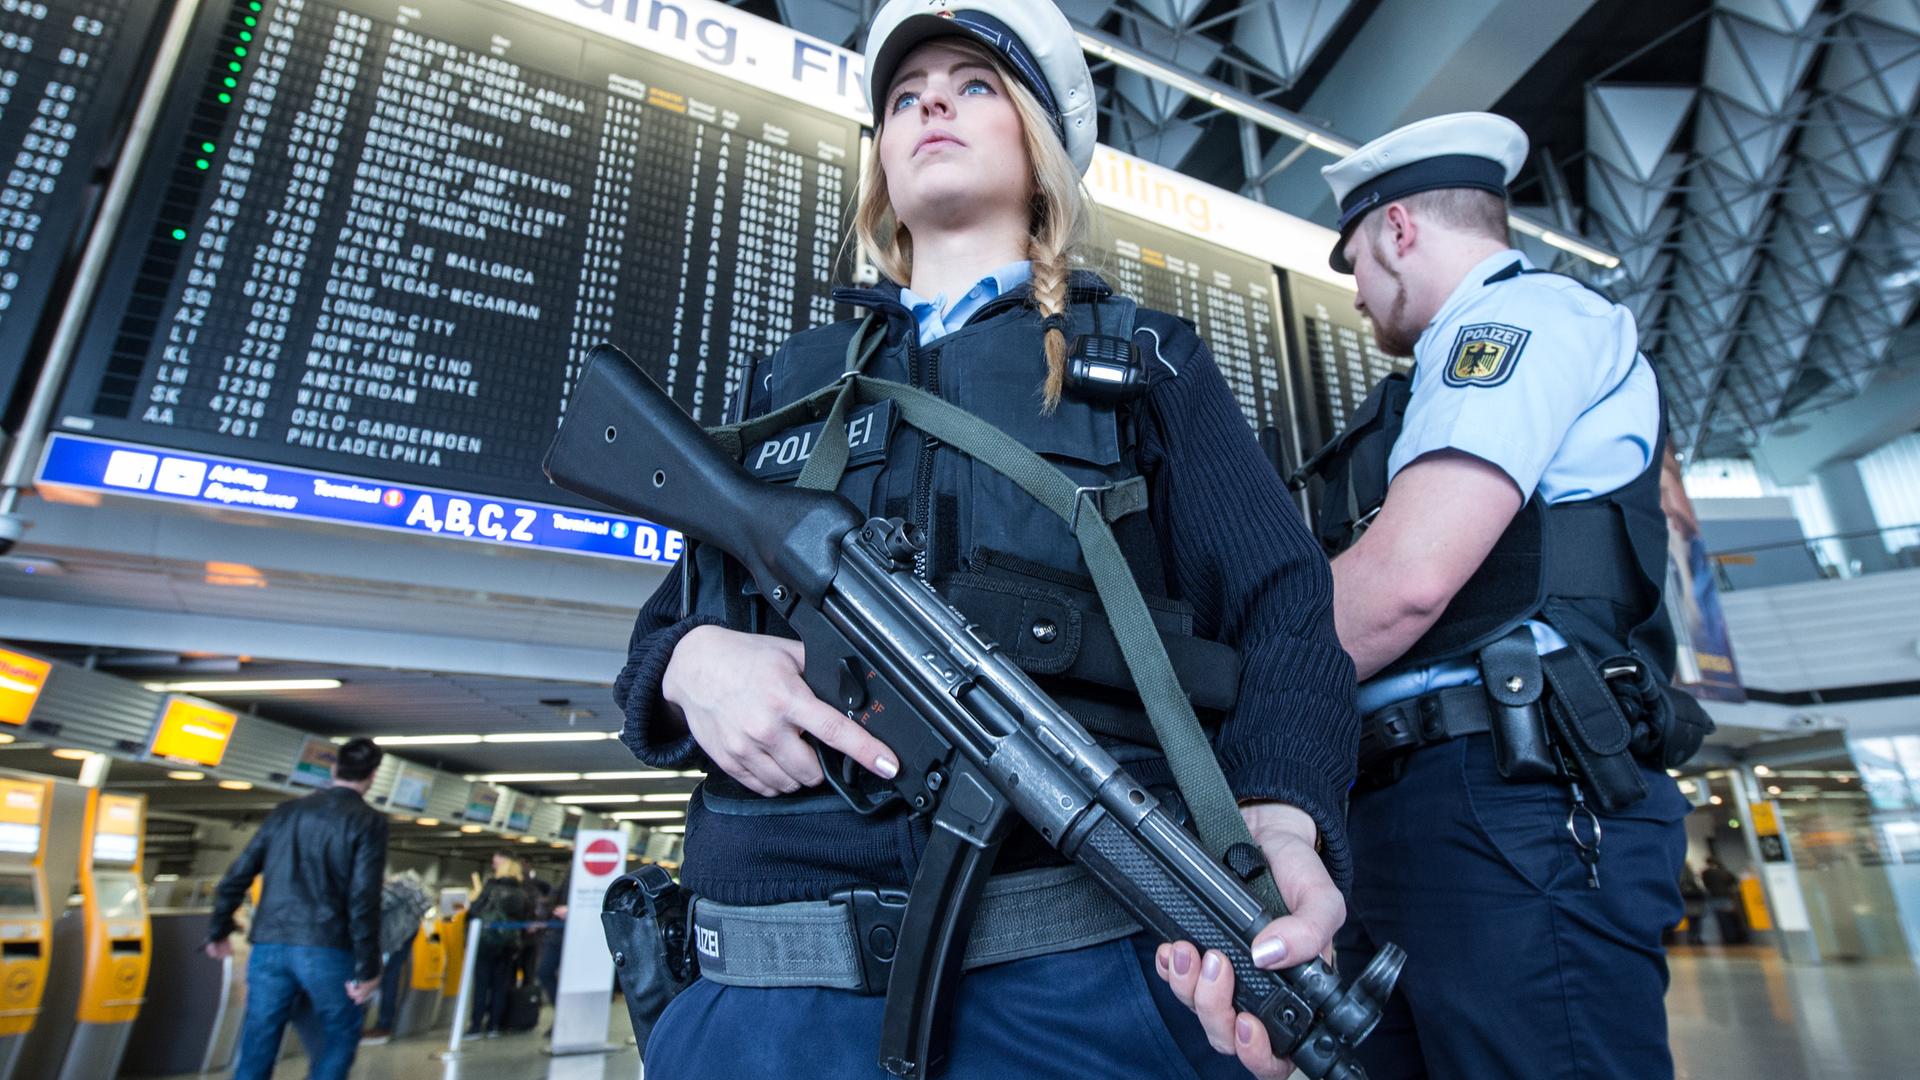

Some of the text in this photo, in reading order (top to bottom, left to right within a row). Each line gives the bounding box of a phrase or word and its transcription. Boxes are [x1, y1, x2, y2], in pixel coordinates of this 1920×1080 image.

[242, 97, 271, 116] SU
[263, 36, 291, 54] LH
[715, 170, 726, 183] A
[272, 6, 300, 25] LH
[718, 144, 729, 157] A
[258, 50, 286, 69] LH
[714, 184, 725, 197] A
[367, 114, 459, 150] BUKAREST
[720, 131, 731, 144] A
[232, 129, 261, 147] LH
[286, 143, 334, 167] 1010
[355, 161, 565, 227] BRUESSEL-ANNULLIERT
[707, 253, 718, 267] A
[238, 113, 266, 132] LH
[288, 126, 339, 151] 3410
[360, 146, 463, 184] STUTTGART
[473, 176, 513, 197] HBF.
[708, 239, 719, 253] A
[286, 178, 324, 199] 204
[350, 193, 486, 240] TOKIO-HANEDA
[352, 177, 543, 238] WASHINGTON-DULLES
[204, 214, 709, 342] AY 822 HELSINKI E
[218, 179, 246, 199] TU
[283, 195, 320, 217] 745
[345, 210, 404, 237] TUNIS
[703, 297, 713, 312] C
[265, 209, 316, 234] 7750
[338, 226, 400, 253] PALMA
[410, 243, 433, 262] DE
[444, 251, 534, 285] MALLORCA
[701, 312, 710, 327] E
[193, 250, 707, 373] LH 1216 GENF A
[242, 279, 296, 304] 8733
[320, 296, 455, 336] LONDON-CITY
[694, 373, 704, 389] E
[329, 261, 368, 282] LAS
[380, 272, 540, 320] VEGAS-MCCARRAN
[698, 342, 709, 358] C
[1463, 327, 1519, 346] POLIZEI
[155, 365, 350, 412] LH 1238 WIEN
[162, 345, 417, 403] KL 1766 AMSTERDAM
[168, 325, 477, 397] LI 272 MAILAND-LINATE
[173, 306, 701, 421] AZ 403 ROM-FIUMICINO E
[250, 300, 290, 322] 025
[315, 314, 416, 347] SINGAPUR
[692, 389, 703, 405] C
[142, 405, 441, 466] AA 701 PHILADELPHIA
[149, 384, 481, 453] SK 4756 OSLO-GARDERMOEN
[754, 412, 874, 470] POLEI
[313, 478, 382, 505] Terminal
[552, 513, 609, 536] Terminal
